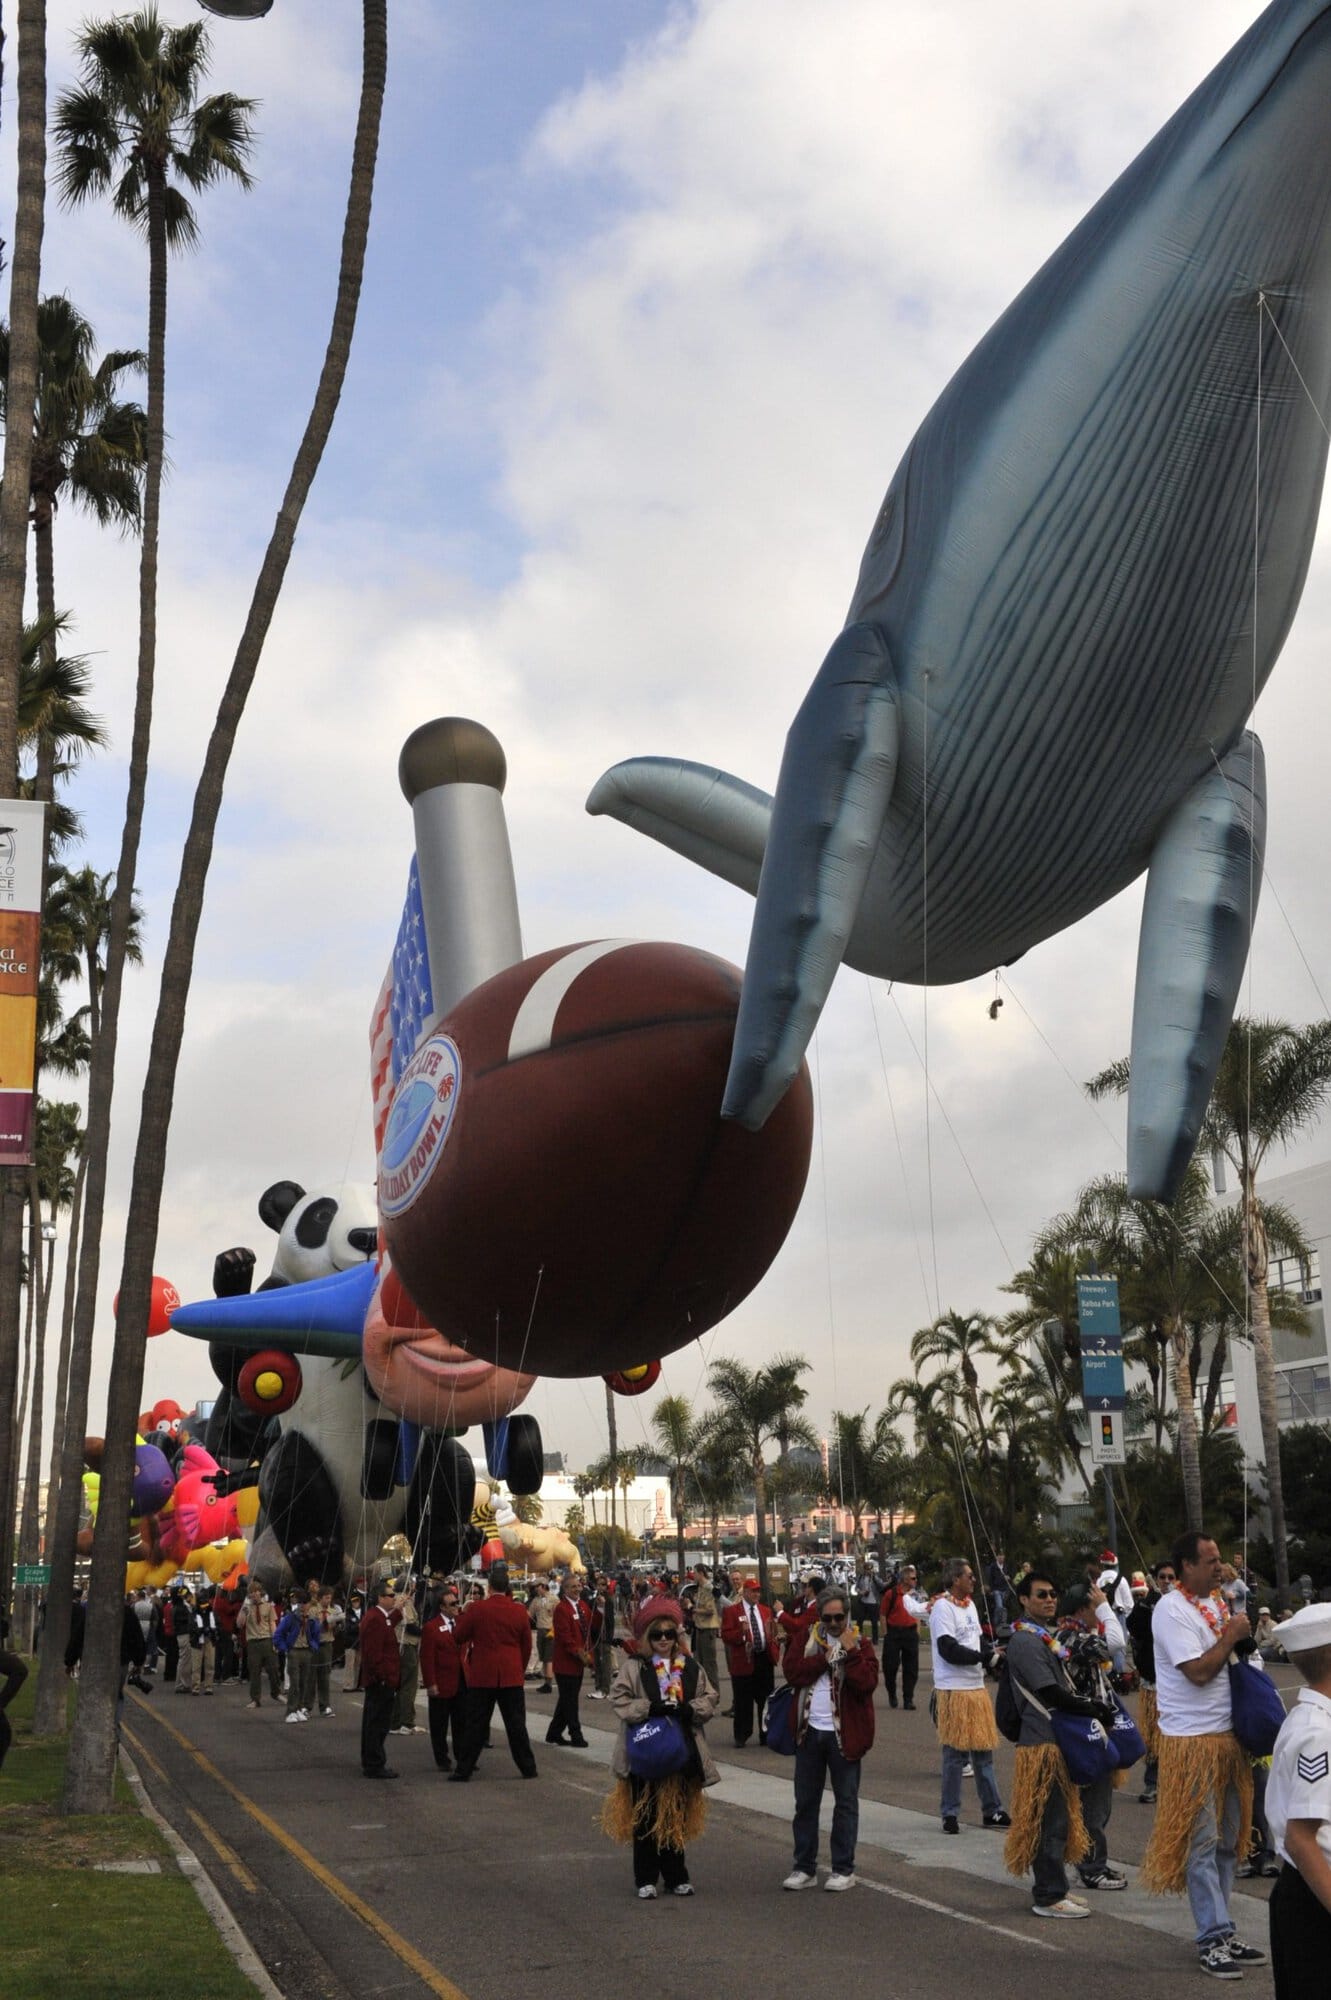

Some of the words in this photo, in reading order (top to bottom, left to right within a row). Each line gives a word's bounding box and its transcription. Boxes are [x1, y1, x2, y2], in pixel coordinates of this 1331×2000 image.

[409, 1114, 446, 1182] BOWL
[1080, 1285, 1107, 1293] Freeways
[1081, 1300, 1101, 1308] Balboa
[1101, 1300, 1115, 1308] Park
[1085, 1360, 1107, 1368] Airport
